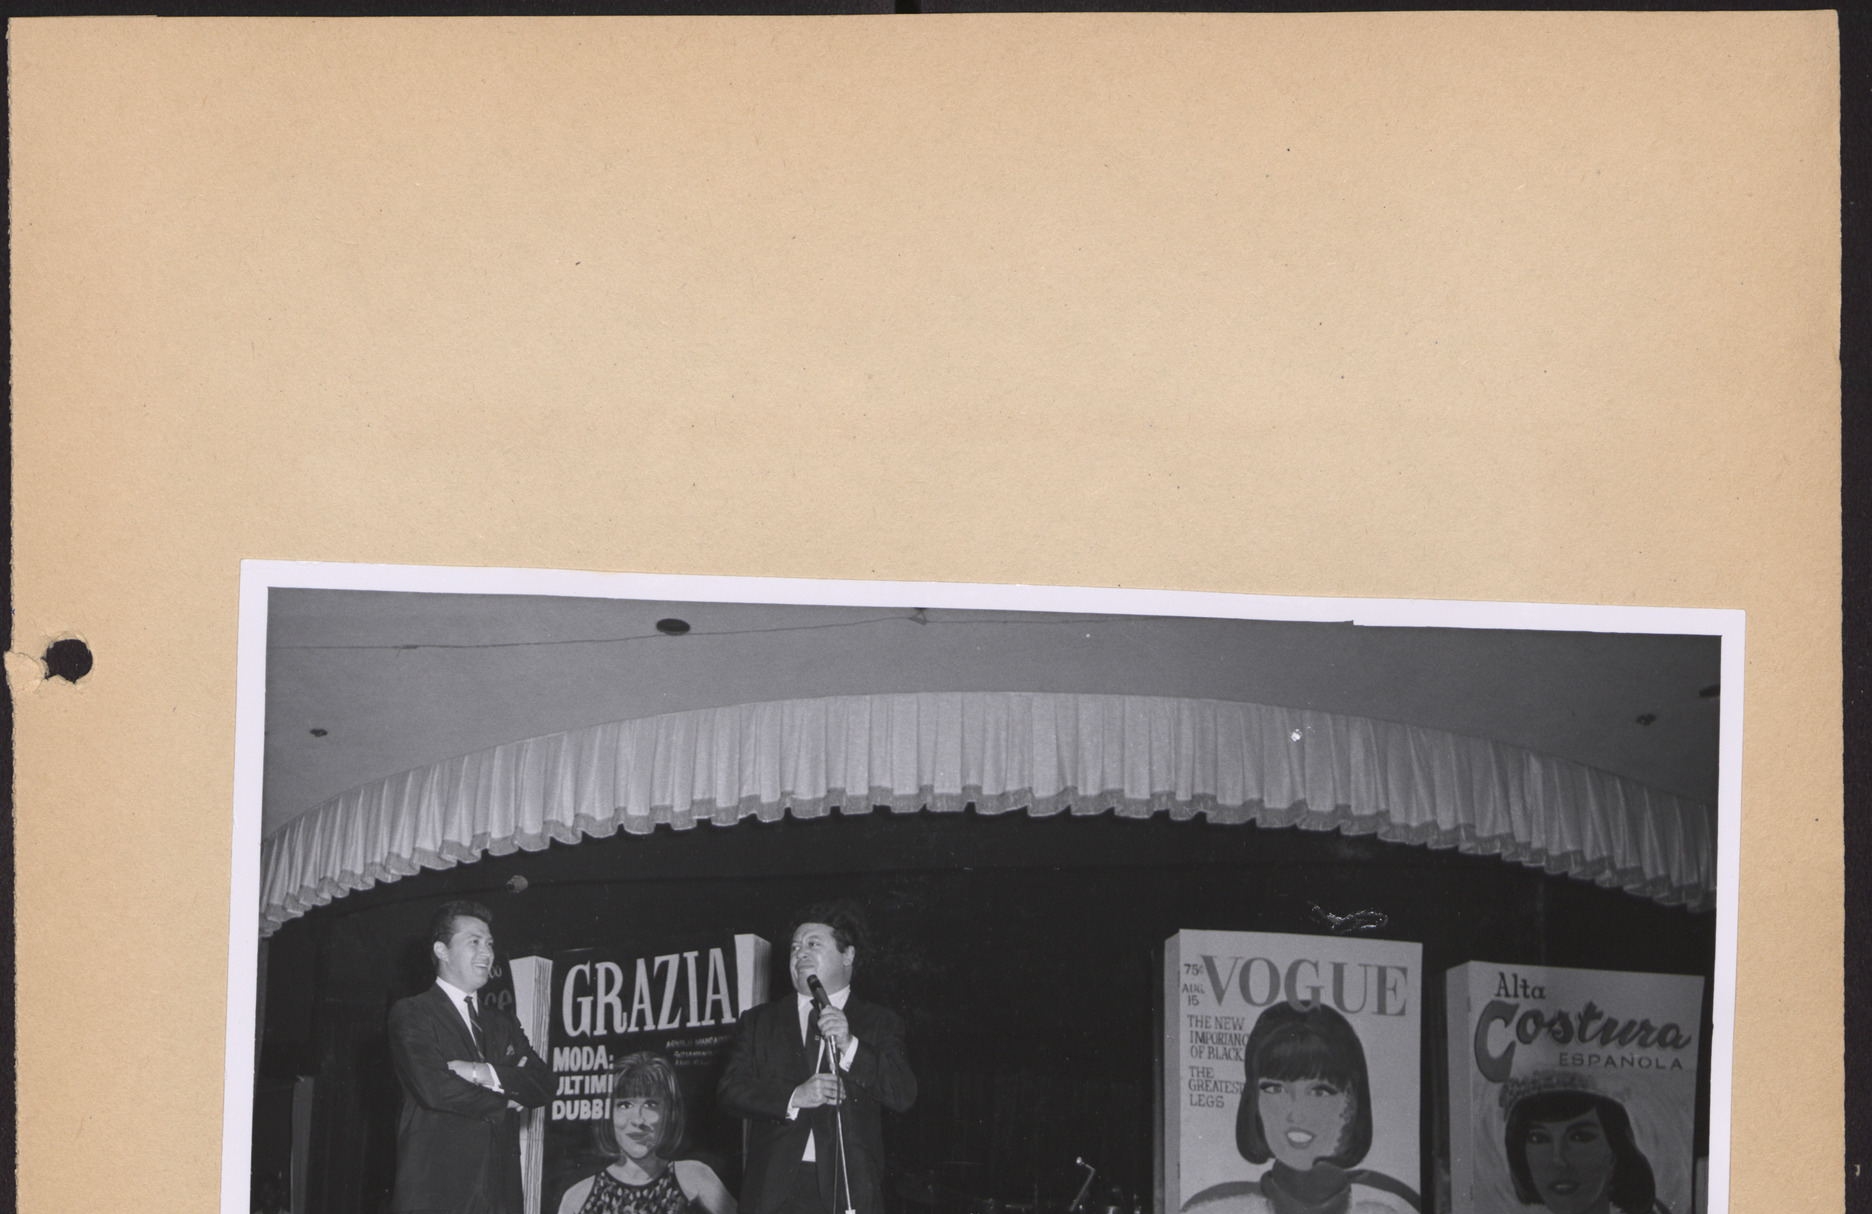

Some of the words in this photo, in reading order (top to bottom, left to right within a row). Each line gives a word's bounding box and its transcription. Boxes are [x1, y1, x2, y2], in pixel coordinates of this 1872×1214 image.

[562, 948, 737, 1038] GRAZIA
[1200, 954, 1408, 1017] VOGUE
[1495, 972, 1547, 1000] Alta
[1187, 994, 1200, 1006] 15
[1187, 1014, 1211, 1029] THE
[1214, 1015, 1245, 1031] NEW
[1189, 1030, 1249, 1047] IMPORTANC
[1474, 999, 1692, 1083] Costura
[552, 1044, 614, 1073] MODA:
[1190, 1044, 1206, 1059] OF
[1207, 1045, 1245, 1062] BLACK
[1188, 1065, 1215, 1079] THE
[551, 1098, 611, 1121] DUBBI
[1189, 1094, 1225, 1109] LEGS
